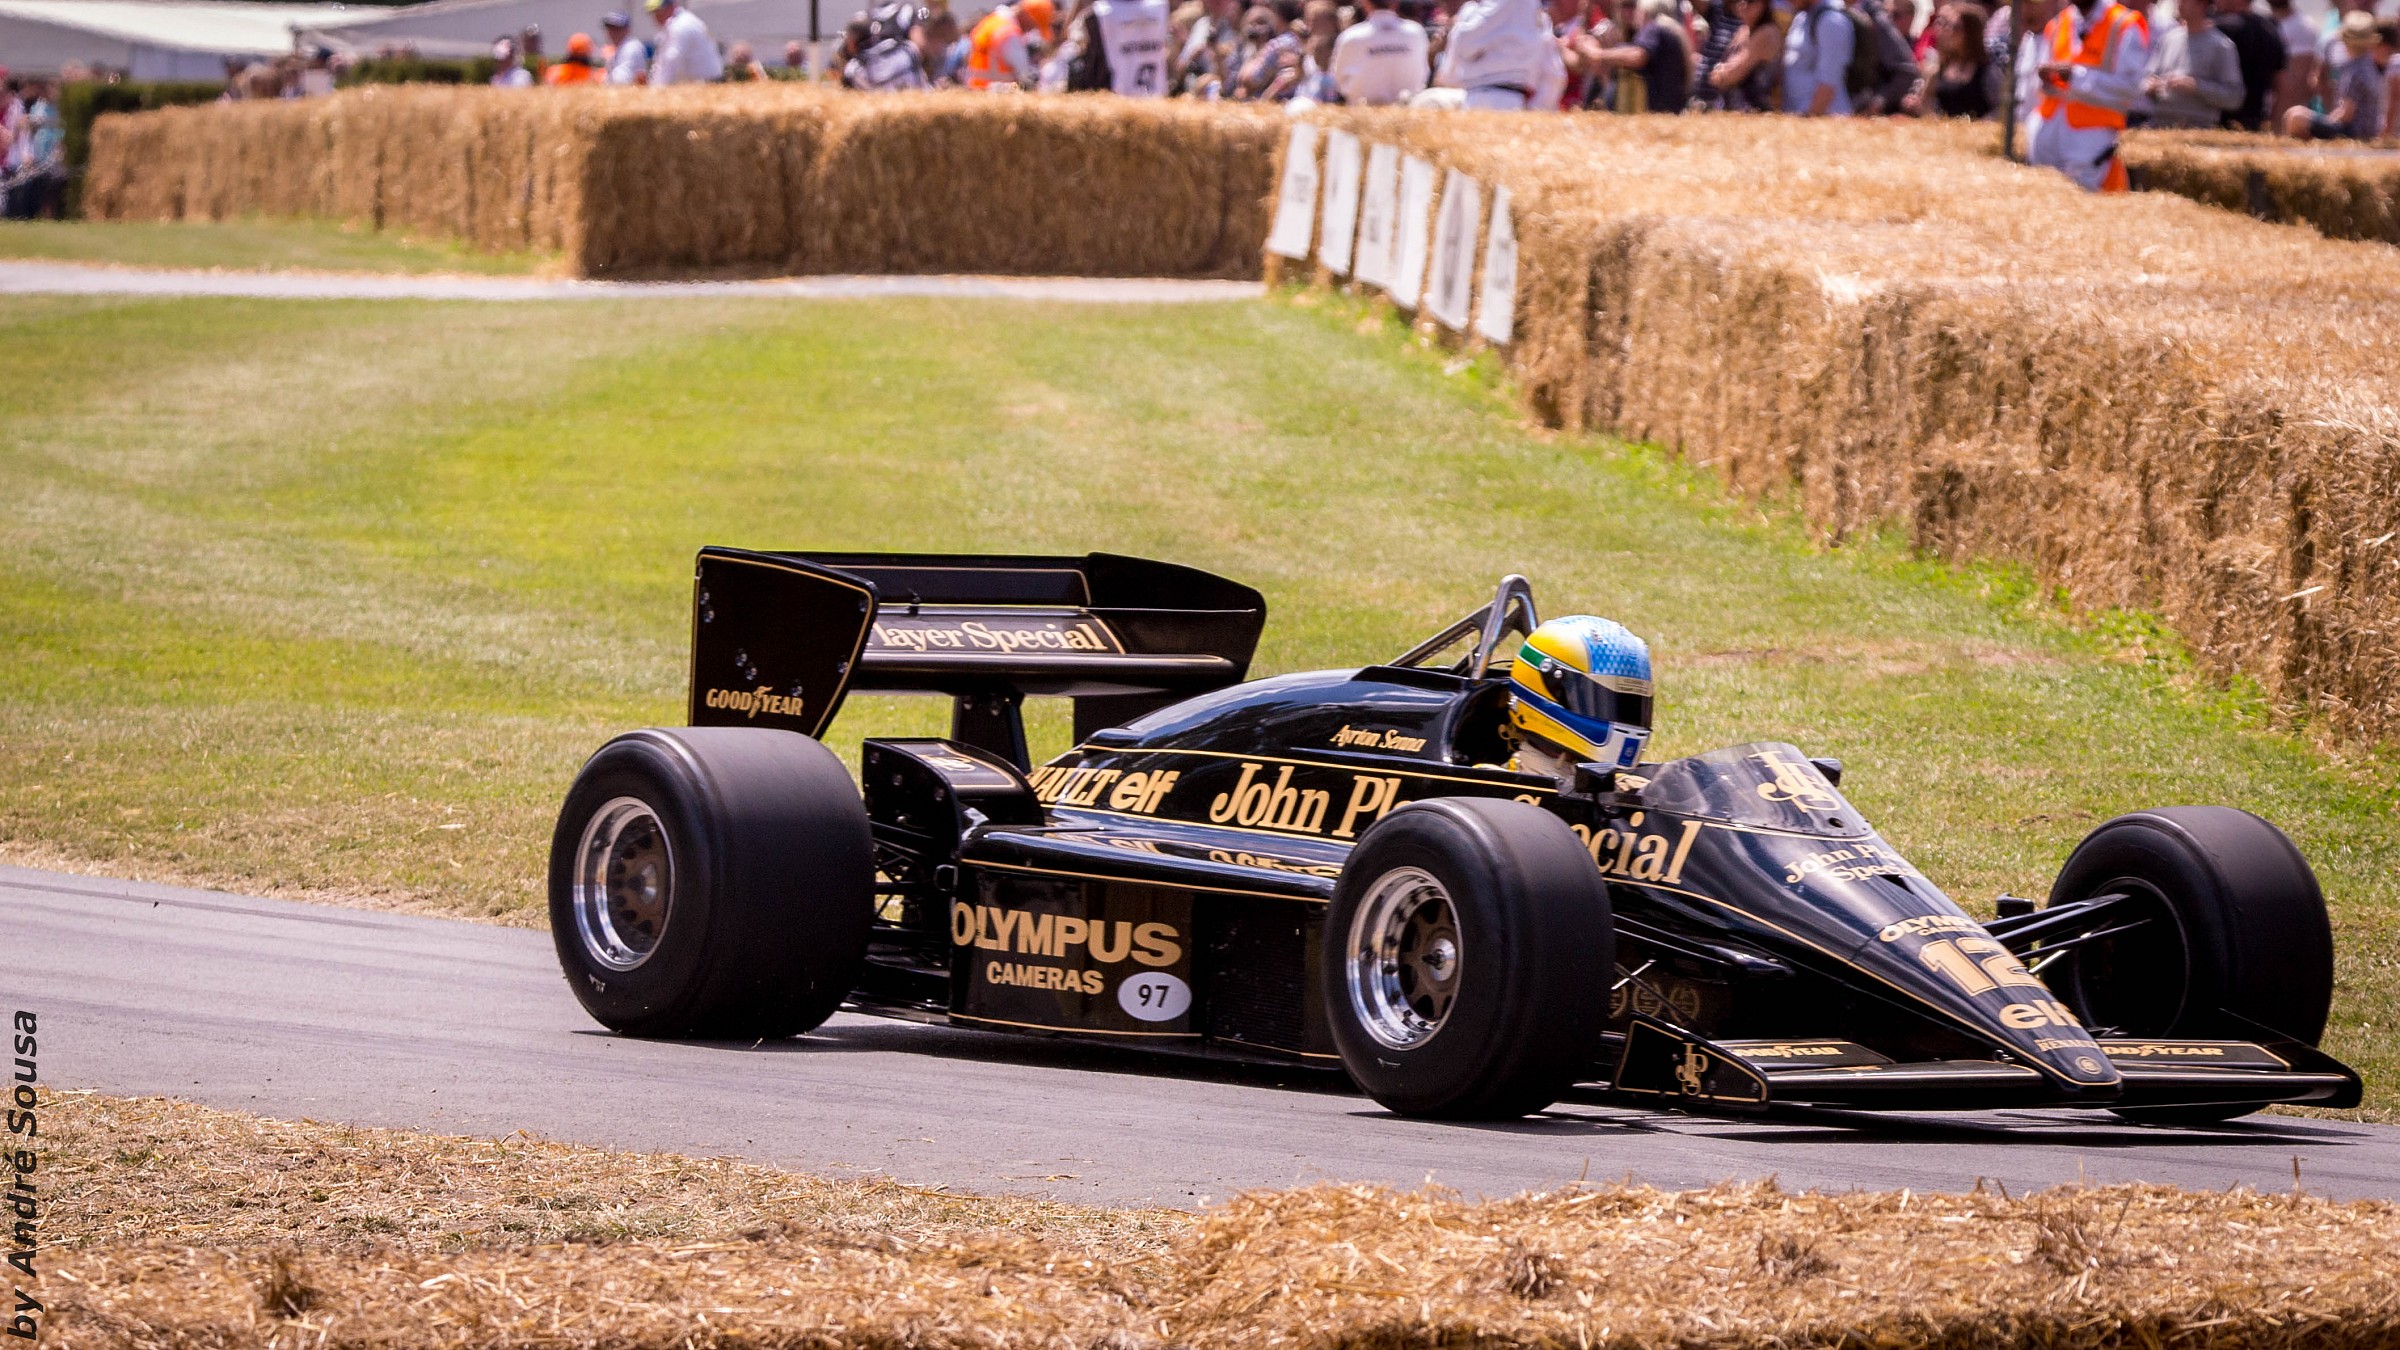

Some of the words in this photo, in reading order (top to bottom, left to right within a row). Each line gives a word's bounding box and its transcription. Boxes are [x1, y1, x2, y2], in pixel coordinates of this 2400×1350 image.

[866, 621, 964, 651] layer
[961, 621, 1108, 654] Special
[706, 686, 804, 718] GOODYEAR
[1110, 770, 1181, 813] elf
[1209, 762, 1331, 834] John
[1332, 775, 1414, 838] Pl
[1784, 849, 1857, 884] John
[952, 901, 1182, 967] OLYMPUS
[986, 961, 1104, 995] CAMERAS
[1918, 937, 2053, 997] 12
[1137, 984, 1170, 1008] 97
